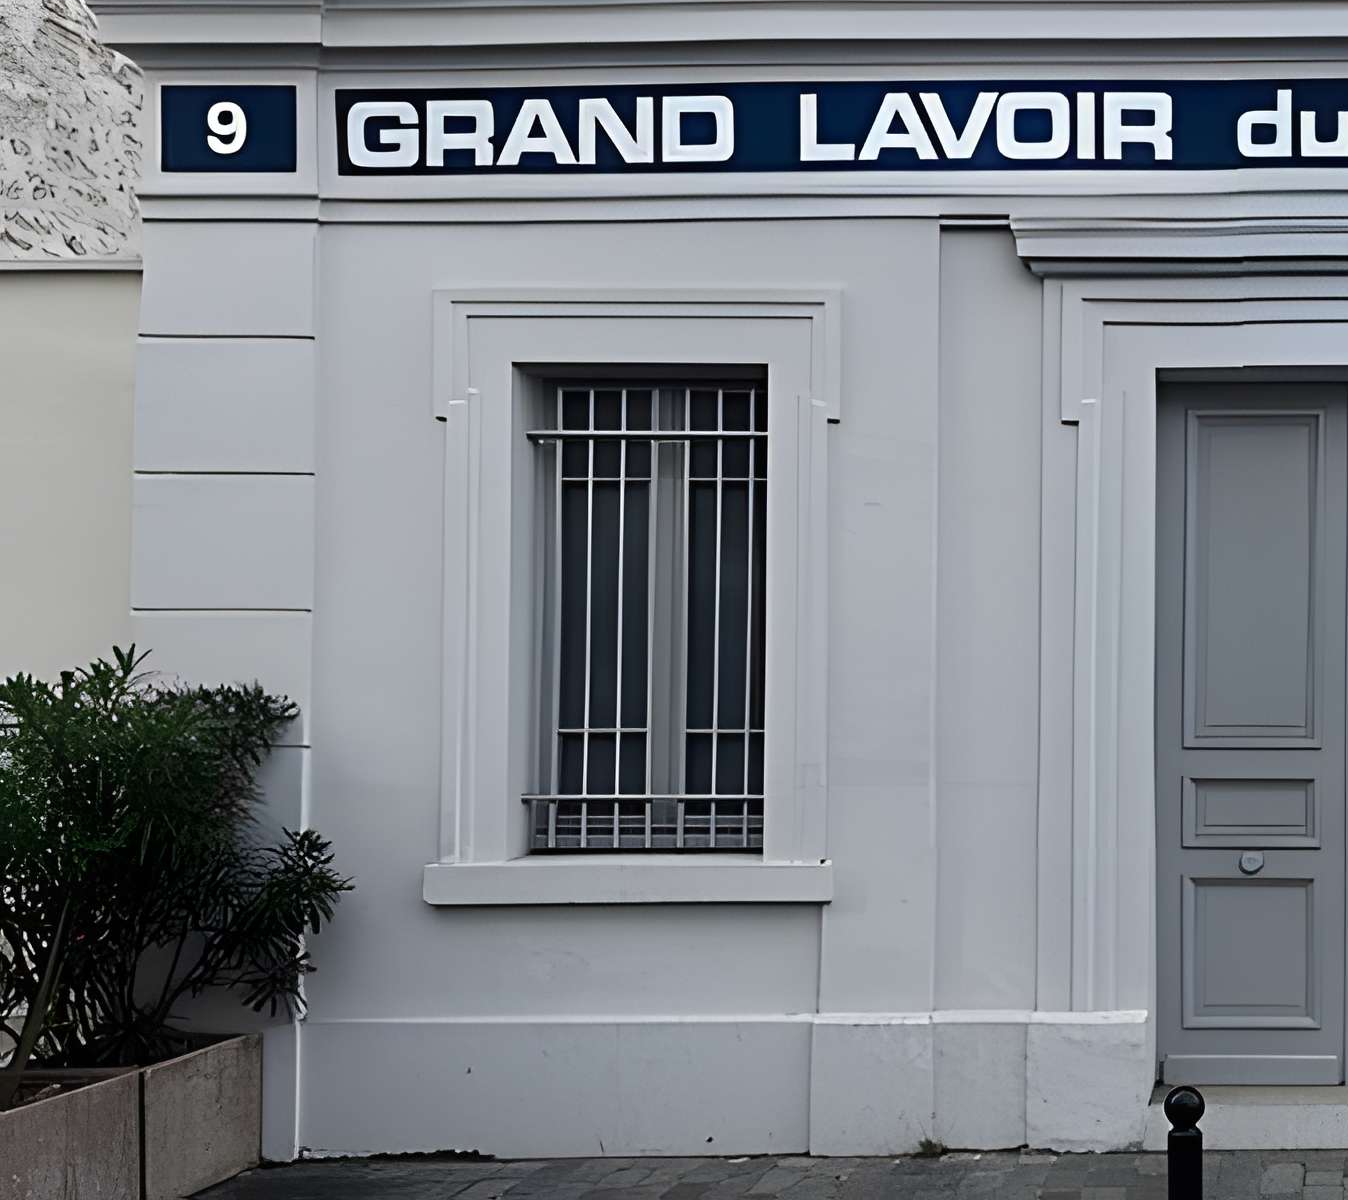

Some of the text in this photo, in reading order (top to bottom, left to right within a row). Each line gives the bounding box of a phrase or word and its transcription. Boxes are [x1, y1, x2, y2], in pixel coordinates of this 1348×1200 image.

[206, 101, 247, 155] 9
[346, 95, 735, 168] GRAND
[799, 91, 1173, 162] LAVOIR
